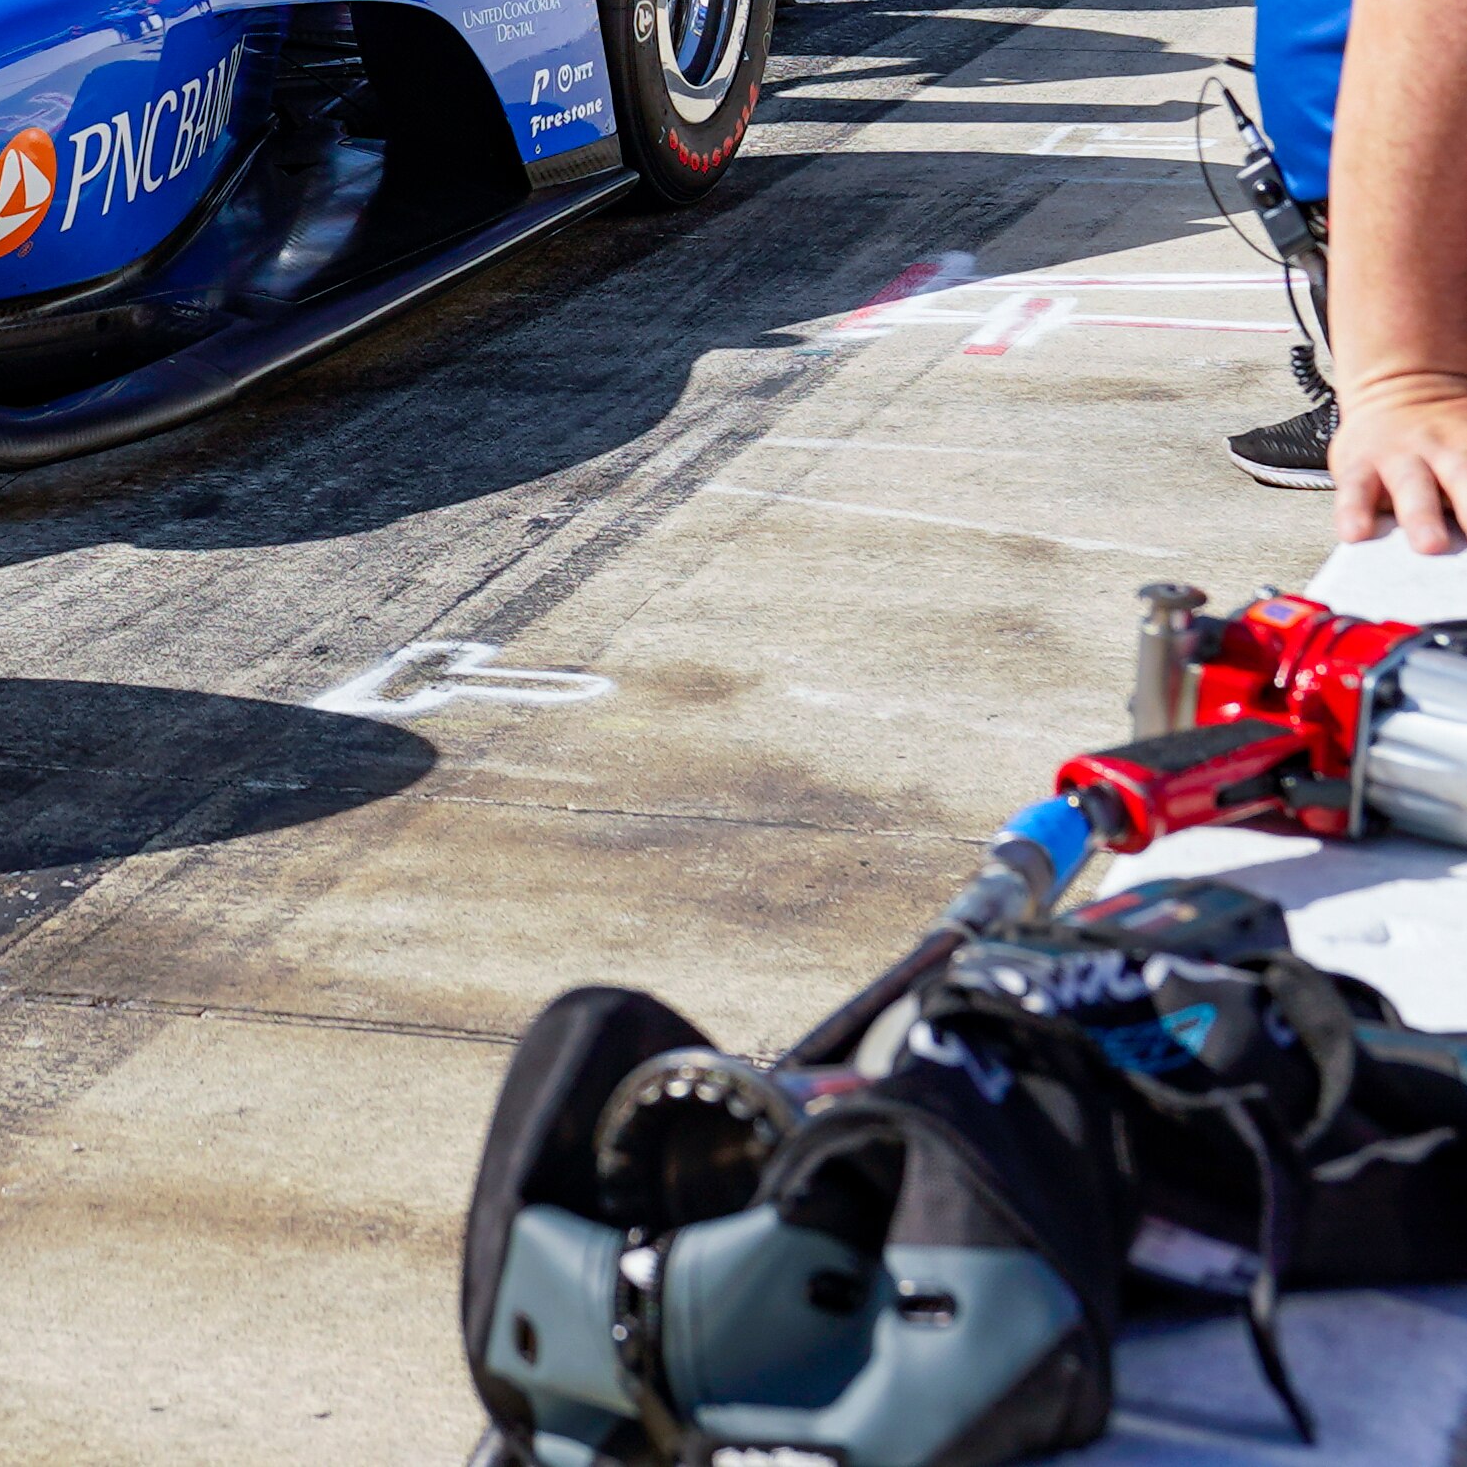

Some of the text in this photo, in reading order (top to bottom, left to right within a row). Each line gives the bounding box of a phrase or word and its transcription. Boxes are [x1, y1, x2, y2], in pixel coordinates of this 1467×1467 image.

[463, 6, 503, 29] UNITED
[497, 20, 535, 44] DENTAL
[574, 61, 594, 83] NTT
[530, 97, 604, 139] Firestone
